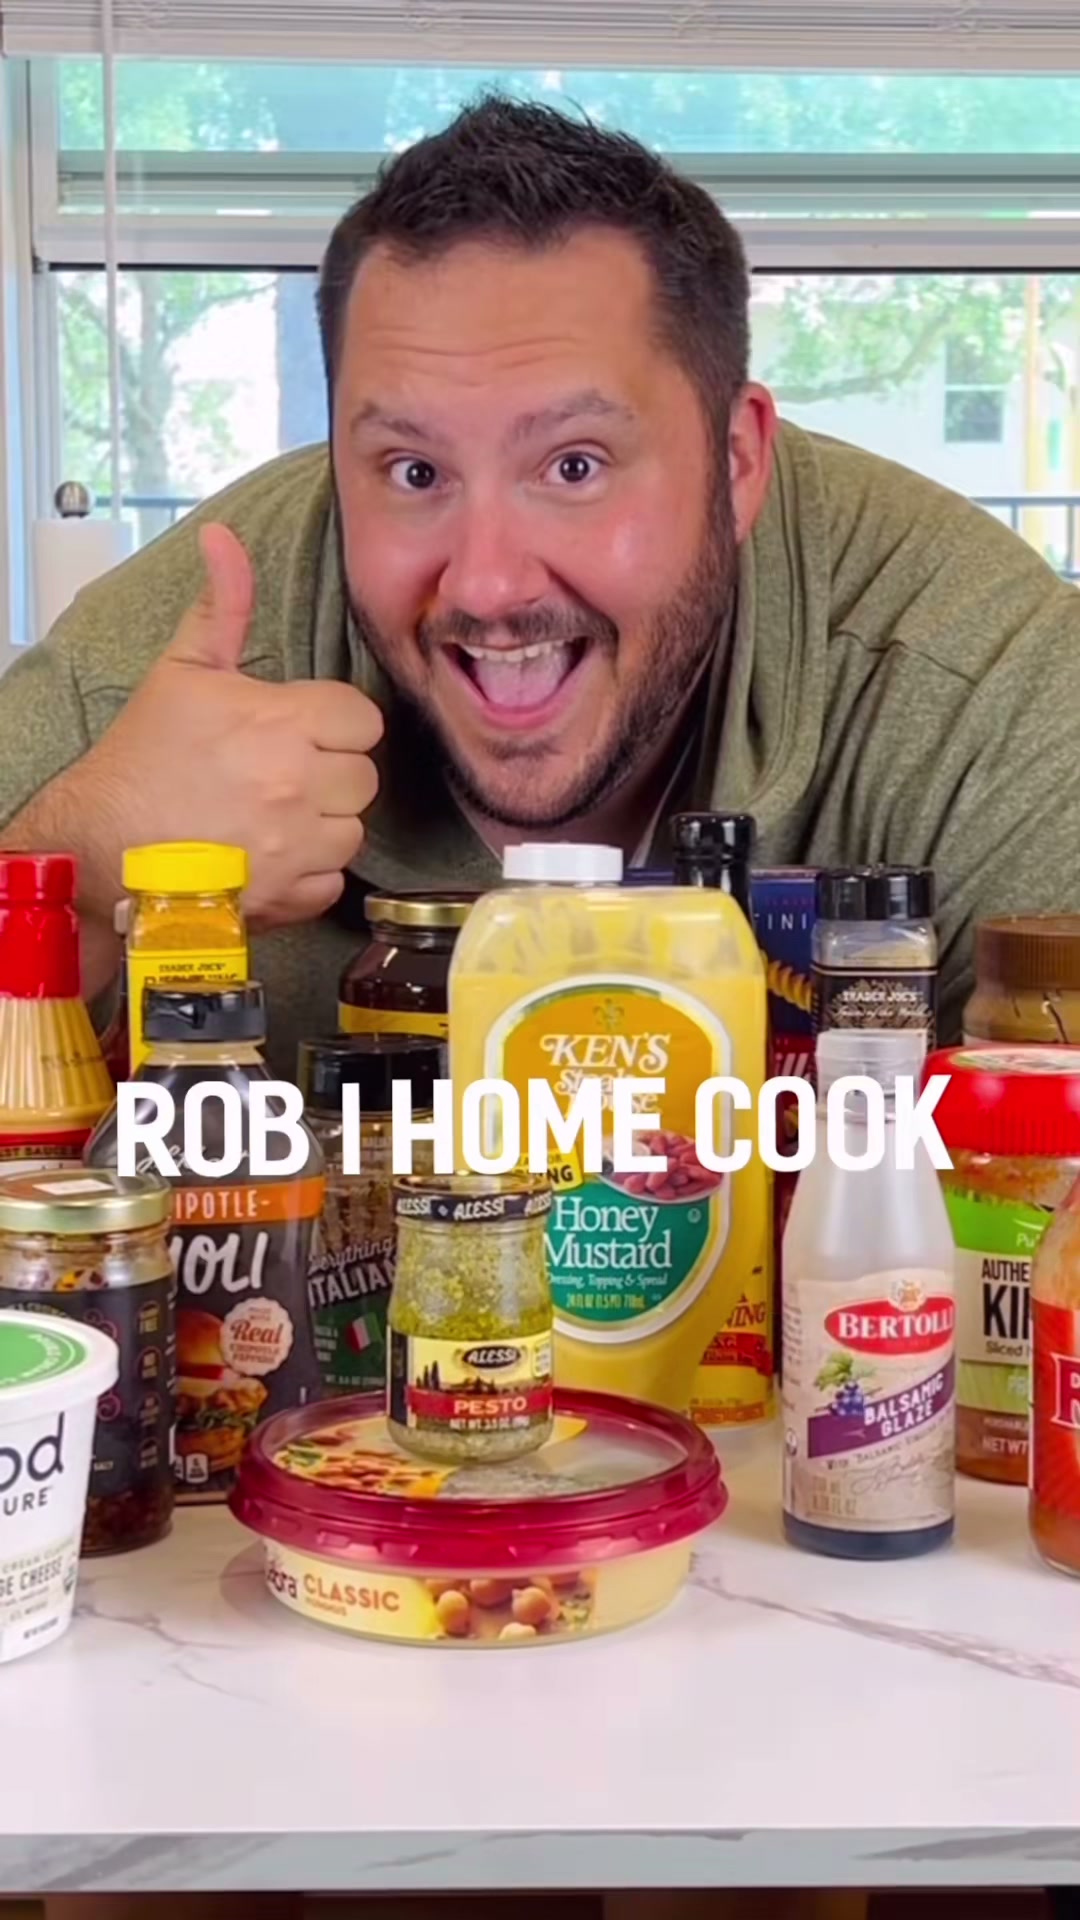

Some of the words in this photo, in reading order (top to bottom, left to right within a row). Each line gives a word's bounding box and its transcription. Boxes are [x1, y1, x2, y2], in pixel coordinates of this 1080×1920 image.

[753, 912, 807, 930] INI
[538, 1032, 671, 1075] KEN'S
[453, 1198, 505, 1221] ALESSI
[553, 1195, 660, 1243] Honey
[543, 1228, 673, 1269] Mustard
[229, 1318, 284, 1345] Real
[837, 1305, 954, 1340] BERTOLLI
[466, 1348, 517, 1365] ALESSI
[985, 1340, 1023, 1357] Sliced
[453, 1396, 527, 1416] PESTO
[863, 1372, 945, 1426] BALSAMIC
[880, 1399, 934, 1438] GLAZE
[20, 1554, 63, 1591] CHEESE
[303, 1572, 401, 1613] CLASSIC
